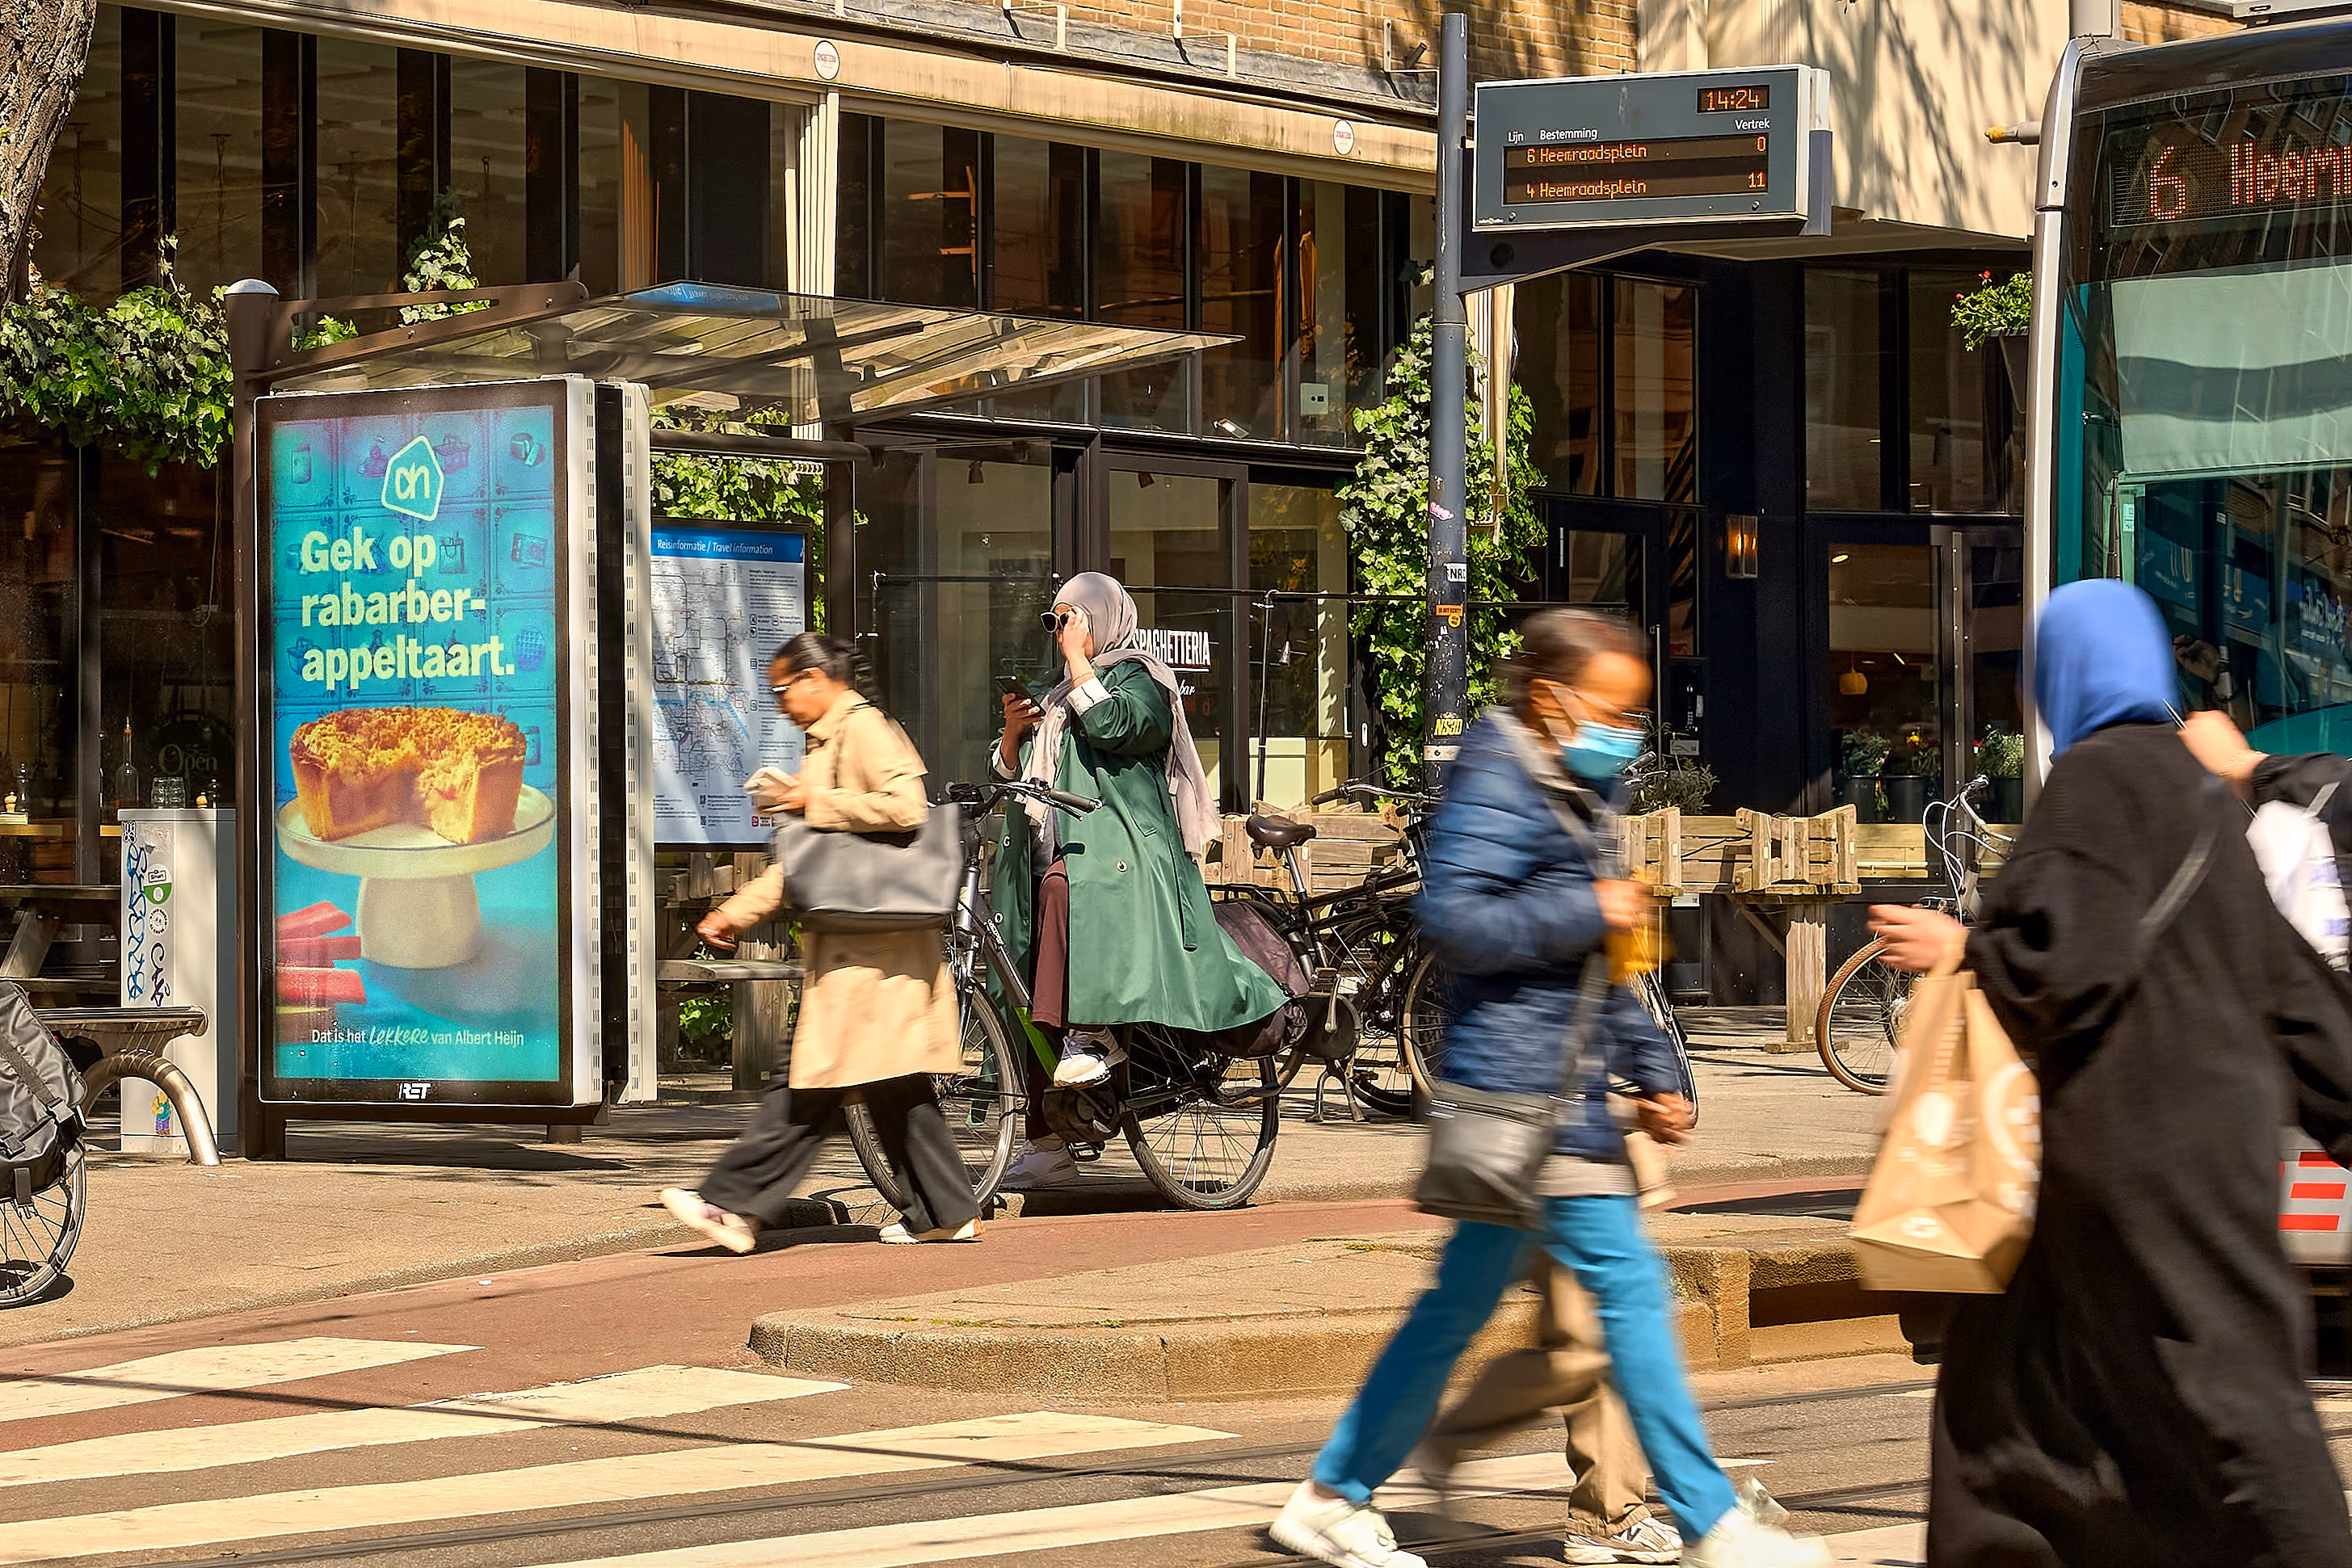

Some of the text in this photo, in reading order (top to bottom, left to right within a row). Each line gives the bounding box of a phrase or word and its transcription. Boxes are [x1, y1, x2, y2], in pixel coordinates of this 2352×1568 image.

[1706, 88, 1761, 111] 14:24
[1508, 117, 1770, 144] Lijn Bestemming Vertrek
[1526, 136, 1766, 164] 6 Heemraadsplein 0
[1526, 171, 1765, 200] 4 Heemraadsplein 11
[2149, 144, 2186, 221] 6
[301, 526, 436, 578] Gek op
[657, 539, 772, 555] Reisinformatie / Travel information
[301, 578, 486, 627] rabarber-
[301, 634, 515, 691] appeltaart.
[312, 1028, 330, 1043] Dat
[332, 1028, 344, 1042] is
[347, 1030, 366, 1043] het
[431, 1034, 453, 1045] van
[455, 1031, 491, 1045] Albert
[494, 1030, 524, 1048] Heijn
